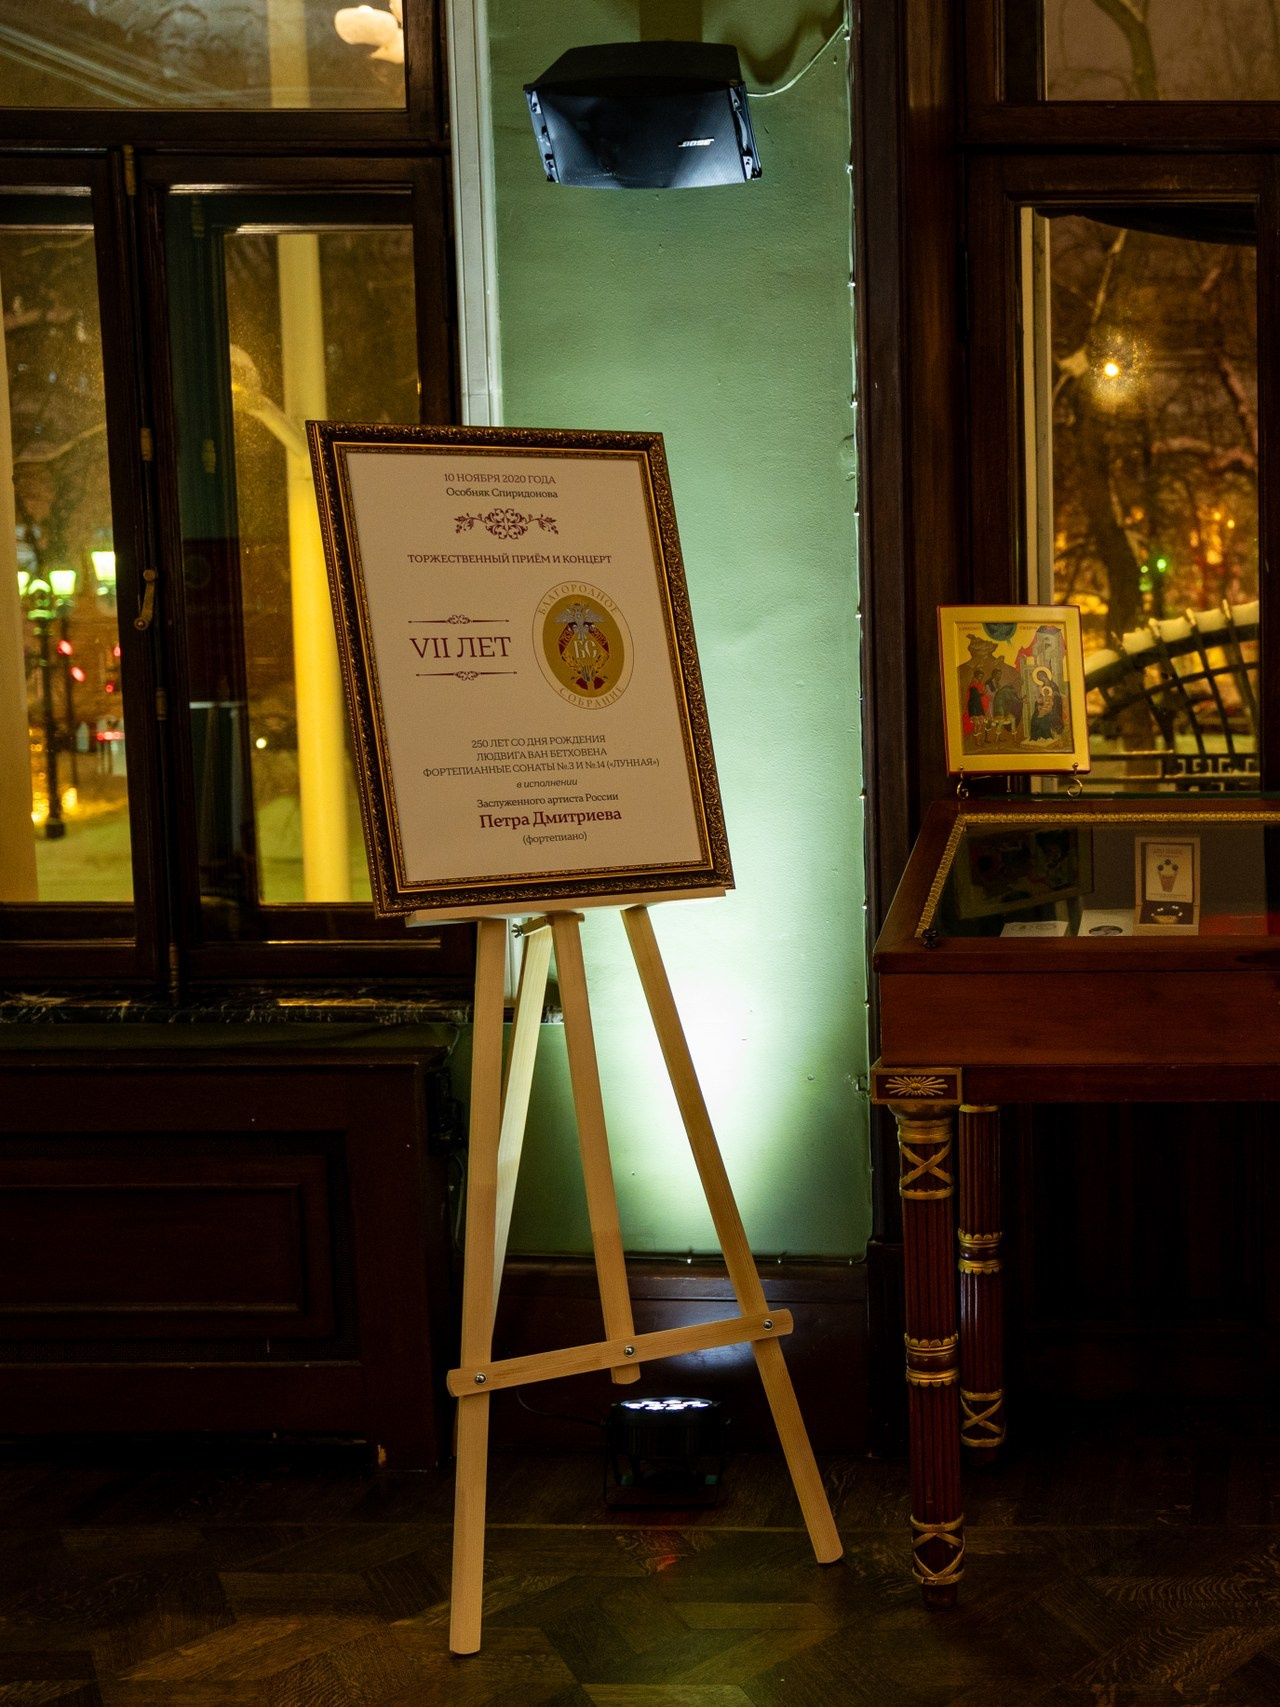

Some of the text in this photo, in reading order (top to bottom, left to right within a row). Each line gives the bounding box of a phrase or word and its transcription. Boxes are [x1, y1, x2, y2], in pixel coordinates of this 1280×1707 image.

[445, 473, 556, 485] 10 НОЯБРЯ 2020 ГОДА
[446, 487, 558, 499] Особняк Спиридонова
[407, 553, 612, 564] ТОРЖЕСТВЕННЫЙ ПРИЁМ И КОНЦЕРТ
[409, 637, 511, 658] VII ЛЕТ
[573, 640, 598, 659] БС
[558, 686, 625, 708] СОБРАНИЕ
[472, 735, 606, 748] 250 ЛЕТ СО ДНЯ РОЖДЕНИЯ
[477, 748, 607, 761] ЛЮДВИГА ВАН БЕТХОВЕНА
[423, 765, 511, 777] ФОРТЕПИАННЫЕ
[512, 763, 555, 772] СОНАТЫ
[607, 758, 659, 769] («ЛУННАЯ»)
[524, 779, 577, 788] исполнении
[477, 793, 618, 810] Заслуженного артиста России
[479, 810, 622, 830] Петра Дмитриева
[523, 831, 587, 845] (фортепиано)
